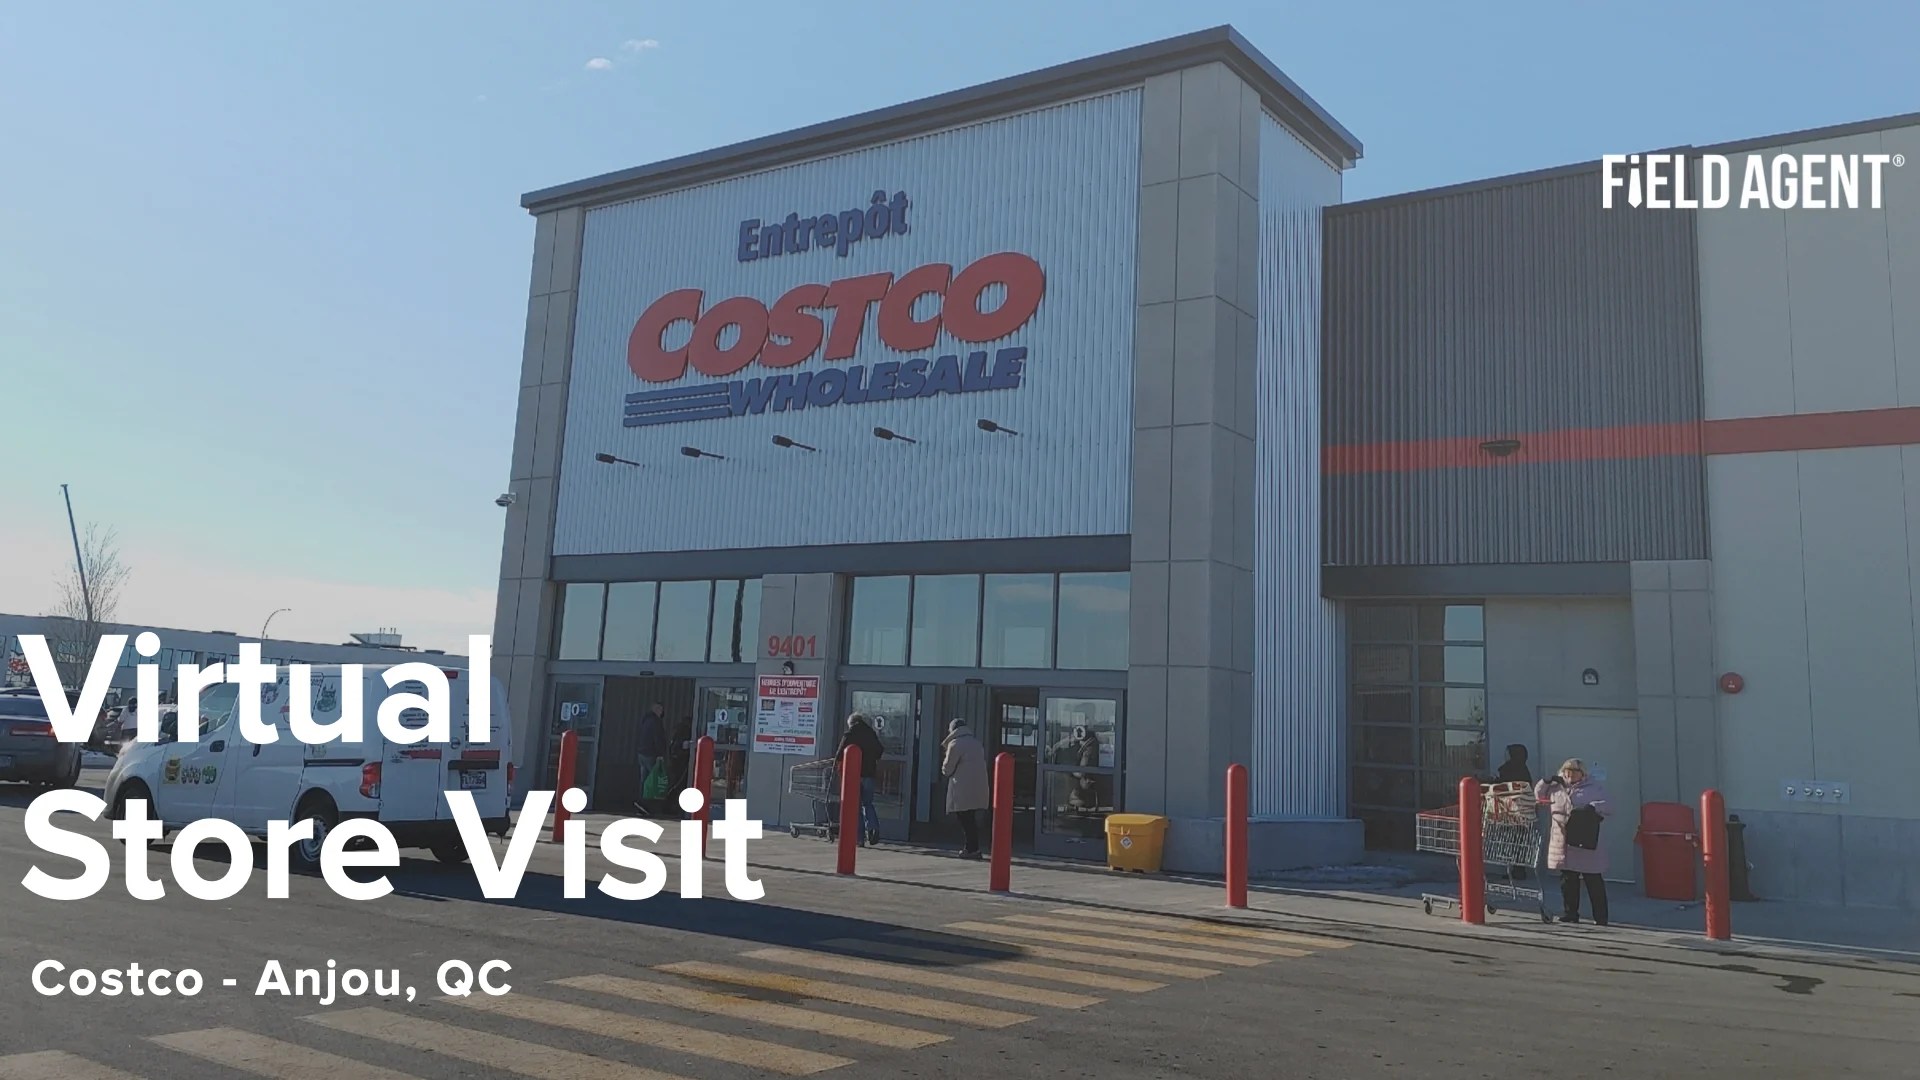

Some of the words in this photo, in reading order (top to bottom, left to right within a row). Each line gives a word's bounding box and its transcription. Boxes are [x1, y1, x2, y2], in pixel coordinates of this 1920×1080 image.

[738, 189, 912, 262] Entrepôt
[627, 251, 1046, 383] COSTCO
[728, 346, 1028, 417] WHOLESALE
[768, 635, 817, 658] 9401
